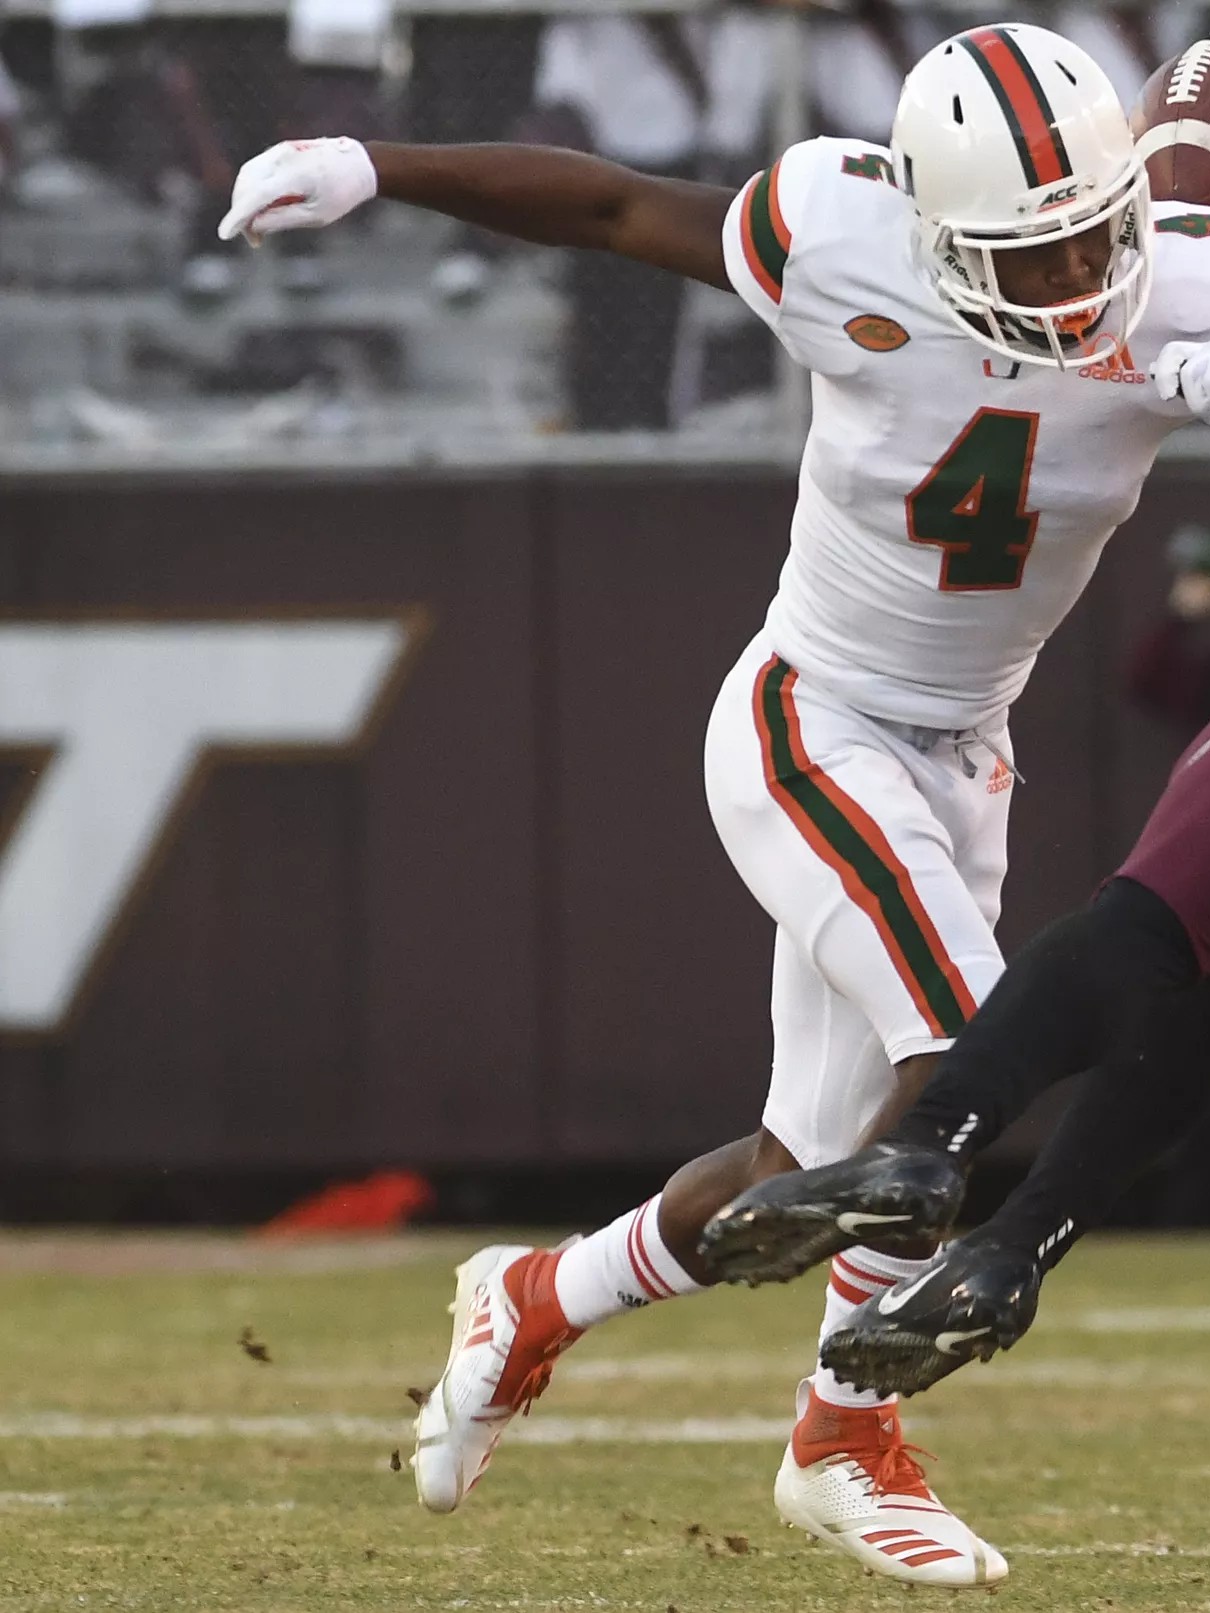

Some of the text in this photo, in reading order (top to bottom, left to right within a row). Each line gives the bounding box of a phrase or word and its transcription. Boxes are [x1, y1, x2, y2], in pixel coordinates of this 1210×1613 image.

[1040, 184, 1078, 204] ACC
[1079, 366, 1146, 384] adidas
[904, 406, 1040, 591] 4
